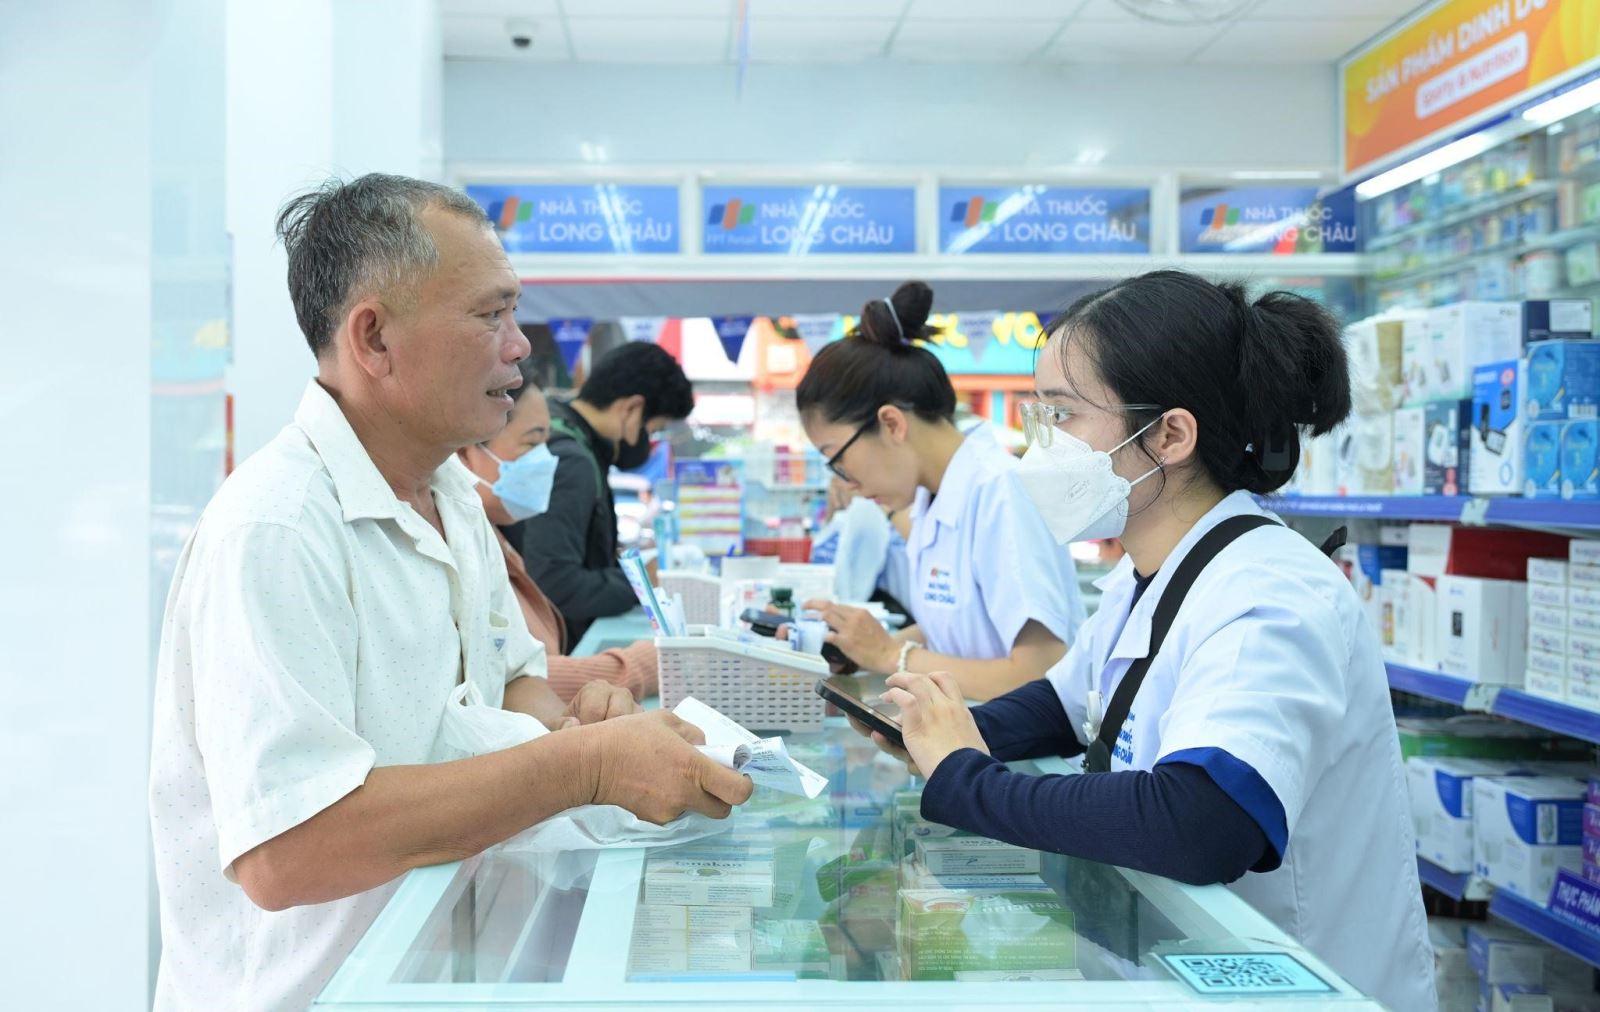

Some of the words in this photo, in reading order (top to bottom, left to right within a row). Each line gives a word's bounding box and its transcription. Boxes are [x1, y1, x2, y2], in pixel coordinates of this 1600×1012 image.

[1457, 2, 1511, 50] DINH
[539, 194, 577, 215] NHÀ
[761, 199, 799, 218] NHÀ
[1047, 194, 1108, 216] THUỐC
[1245, 202, 1276, 220] NHÀ
[539, 221, 603, 242] LONG
[761, 224, 826, 245] LONG
[831, 220, 894, 245] CHÂU
[1004, 221, 1068, 242] LONG
[1073, 217, 1137, 242] CHÂU
[1303, 221, 1357, 242] CHÂU
